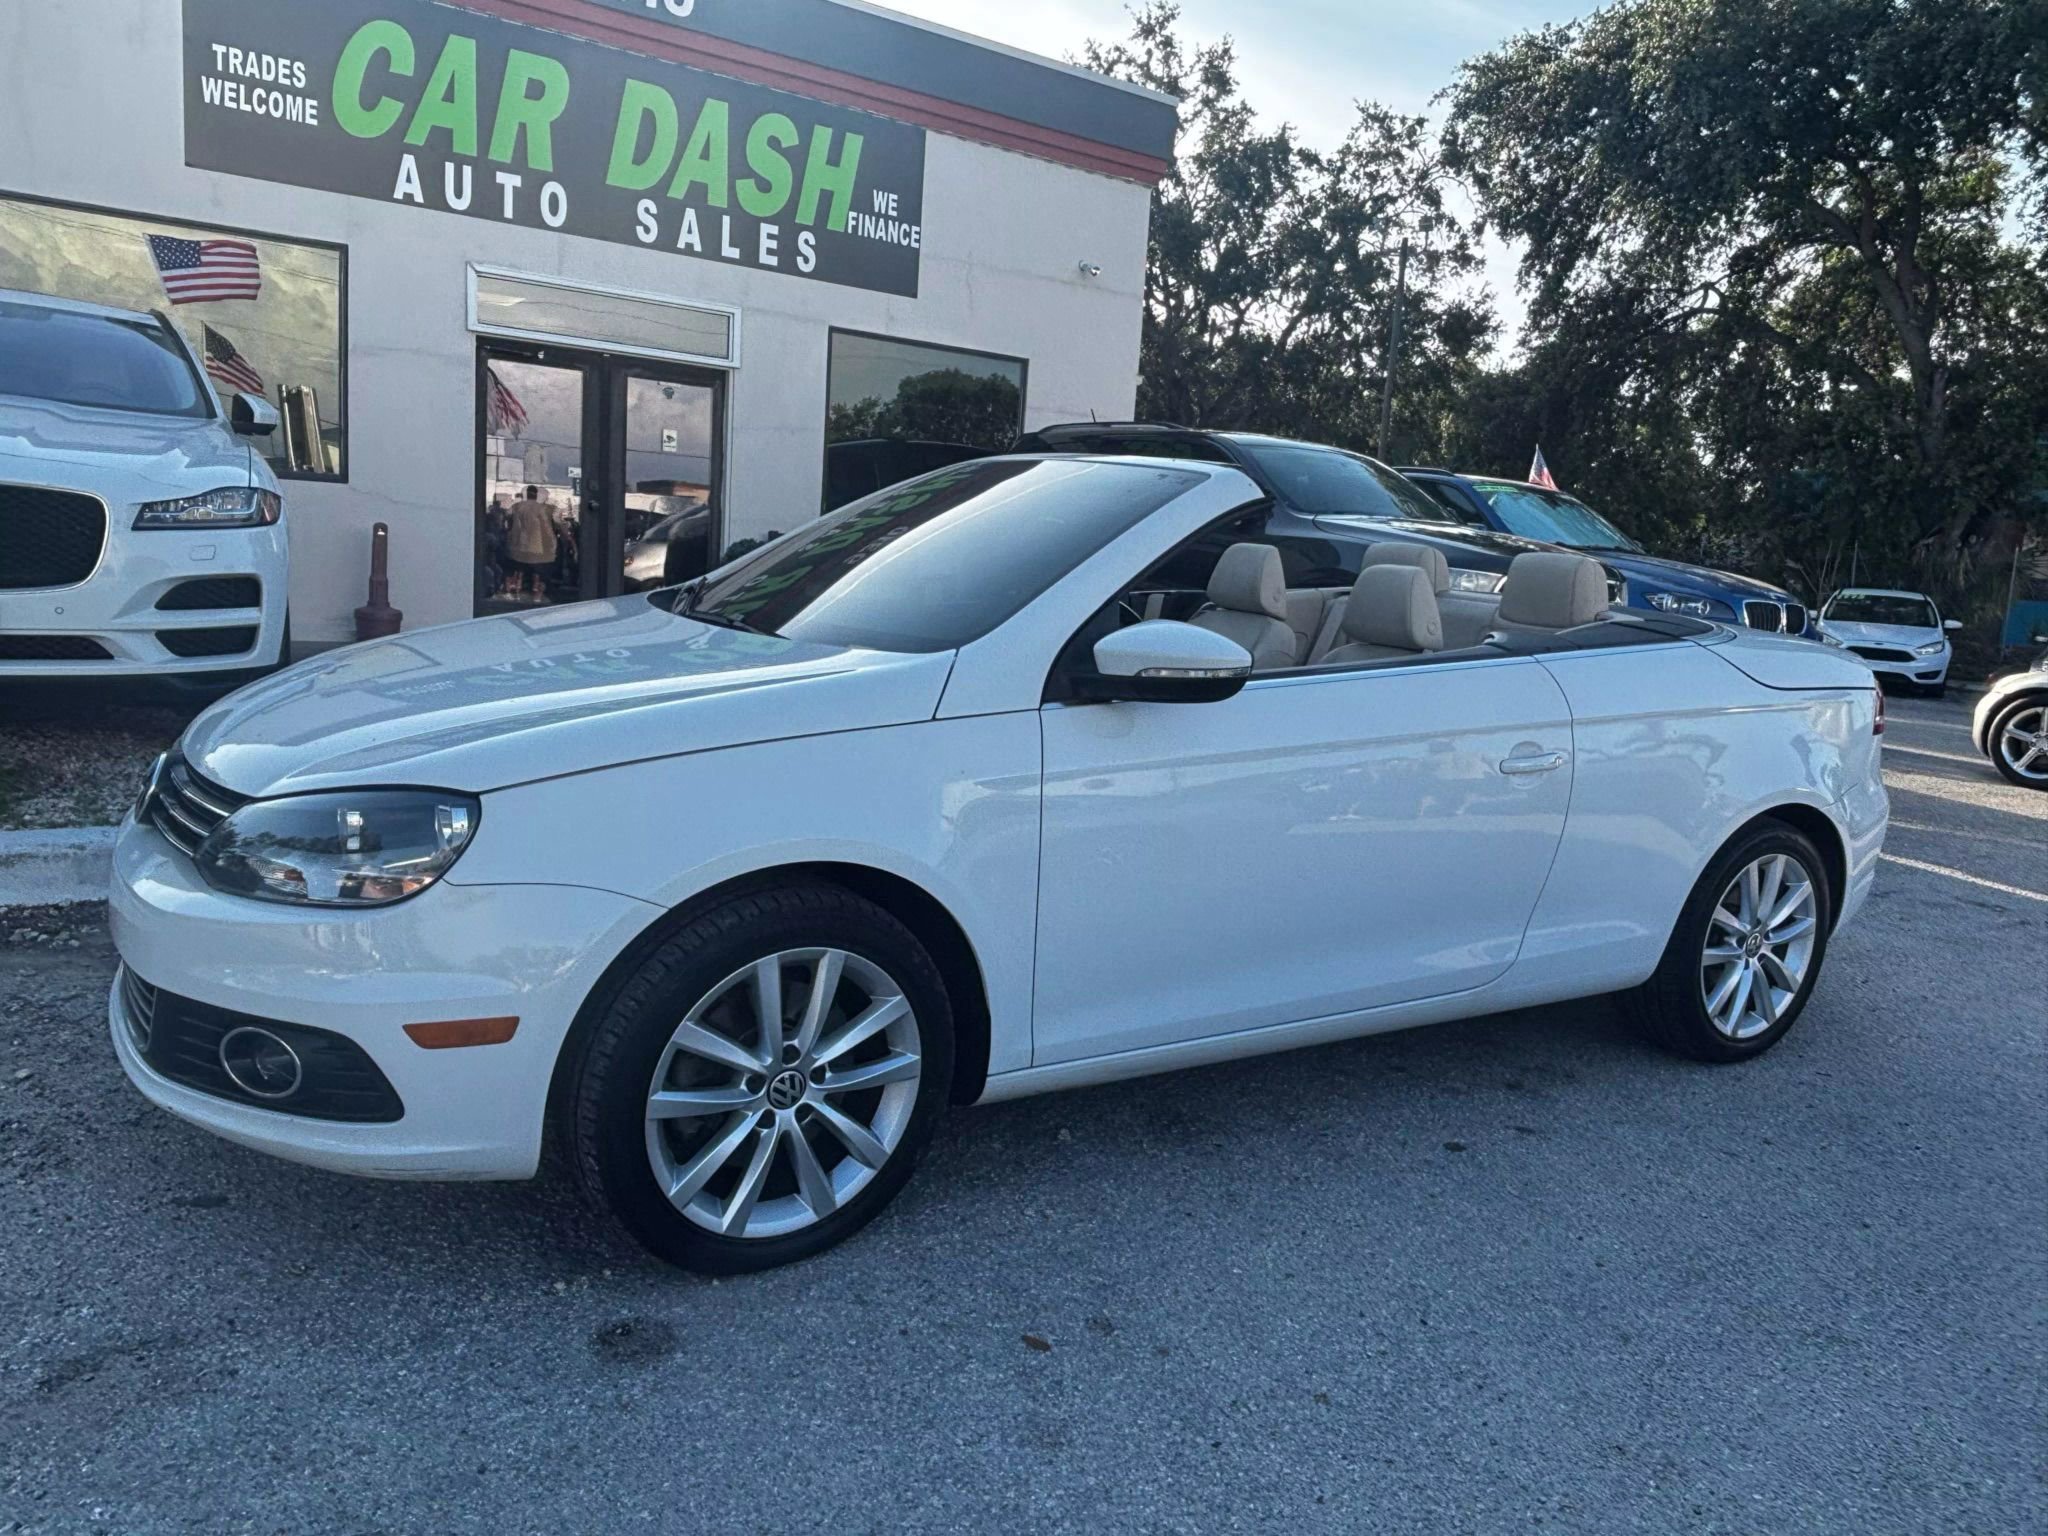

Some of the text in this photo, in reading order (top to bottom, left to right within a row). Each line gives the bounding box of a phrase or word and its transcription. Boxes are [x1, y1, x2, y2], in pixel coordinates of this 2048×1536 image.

[211, 43, 307, 89] TRADES
[201, 75, 319, 126] WELCOME
[332, 19, 864, 233] CAR DASH
[393, 153, 817, 273] AUTO SALES
[873, 189, 899, 217] WE
[847, 210, 921, 249] FINANCE
